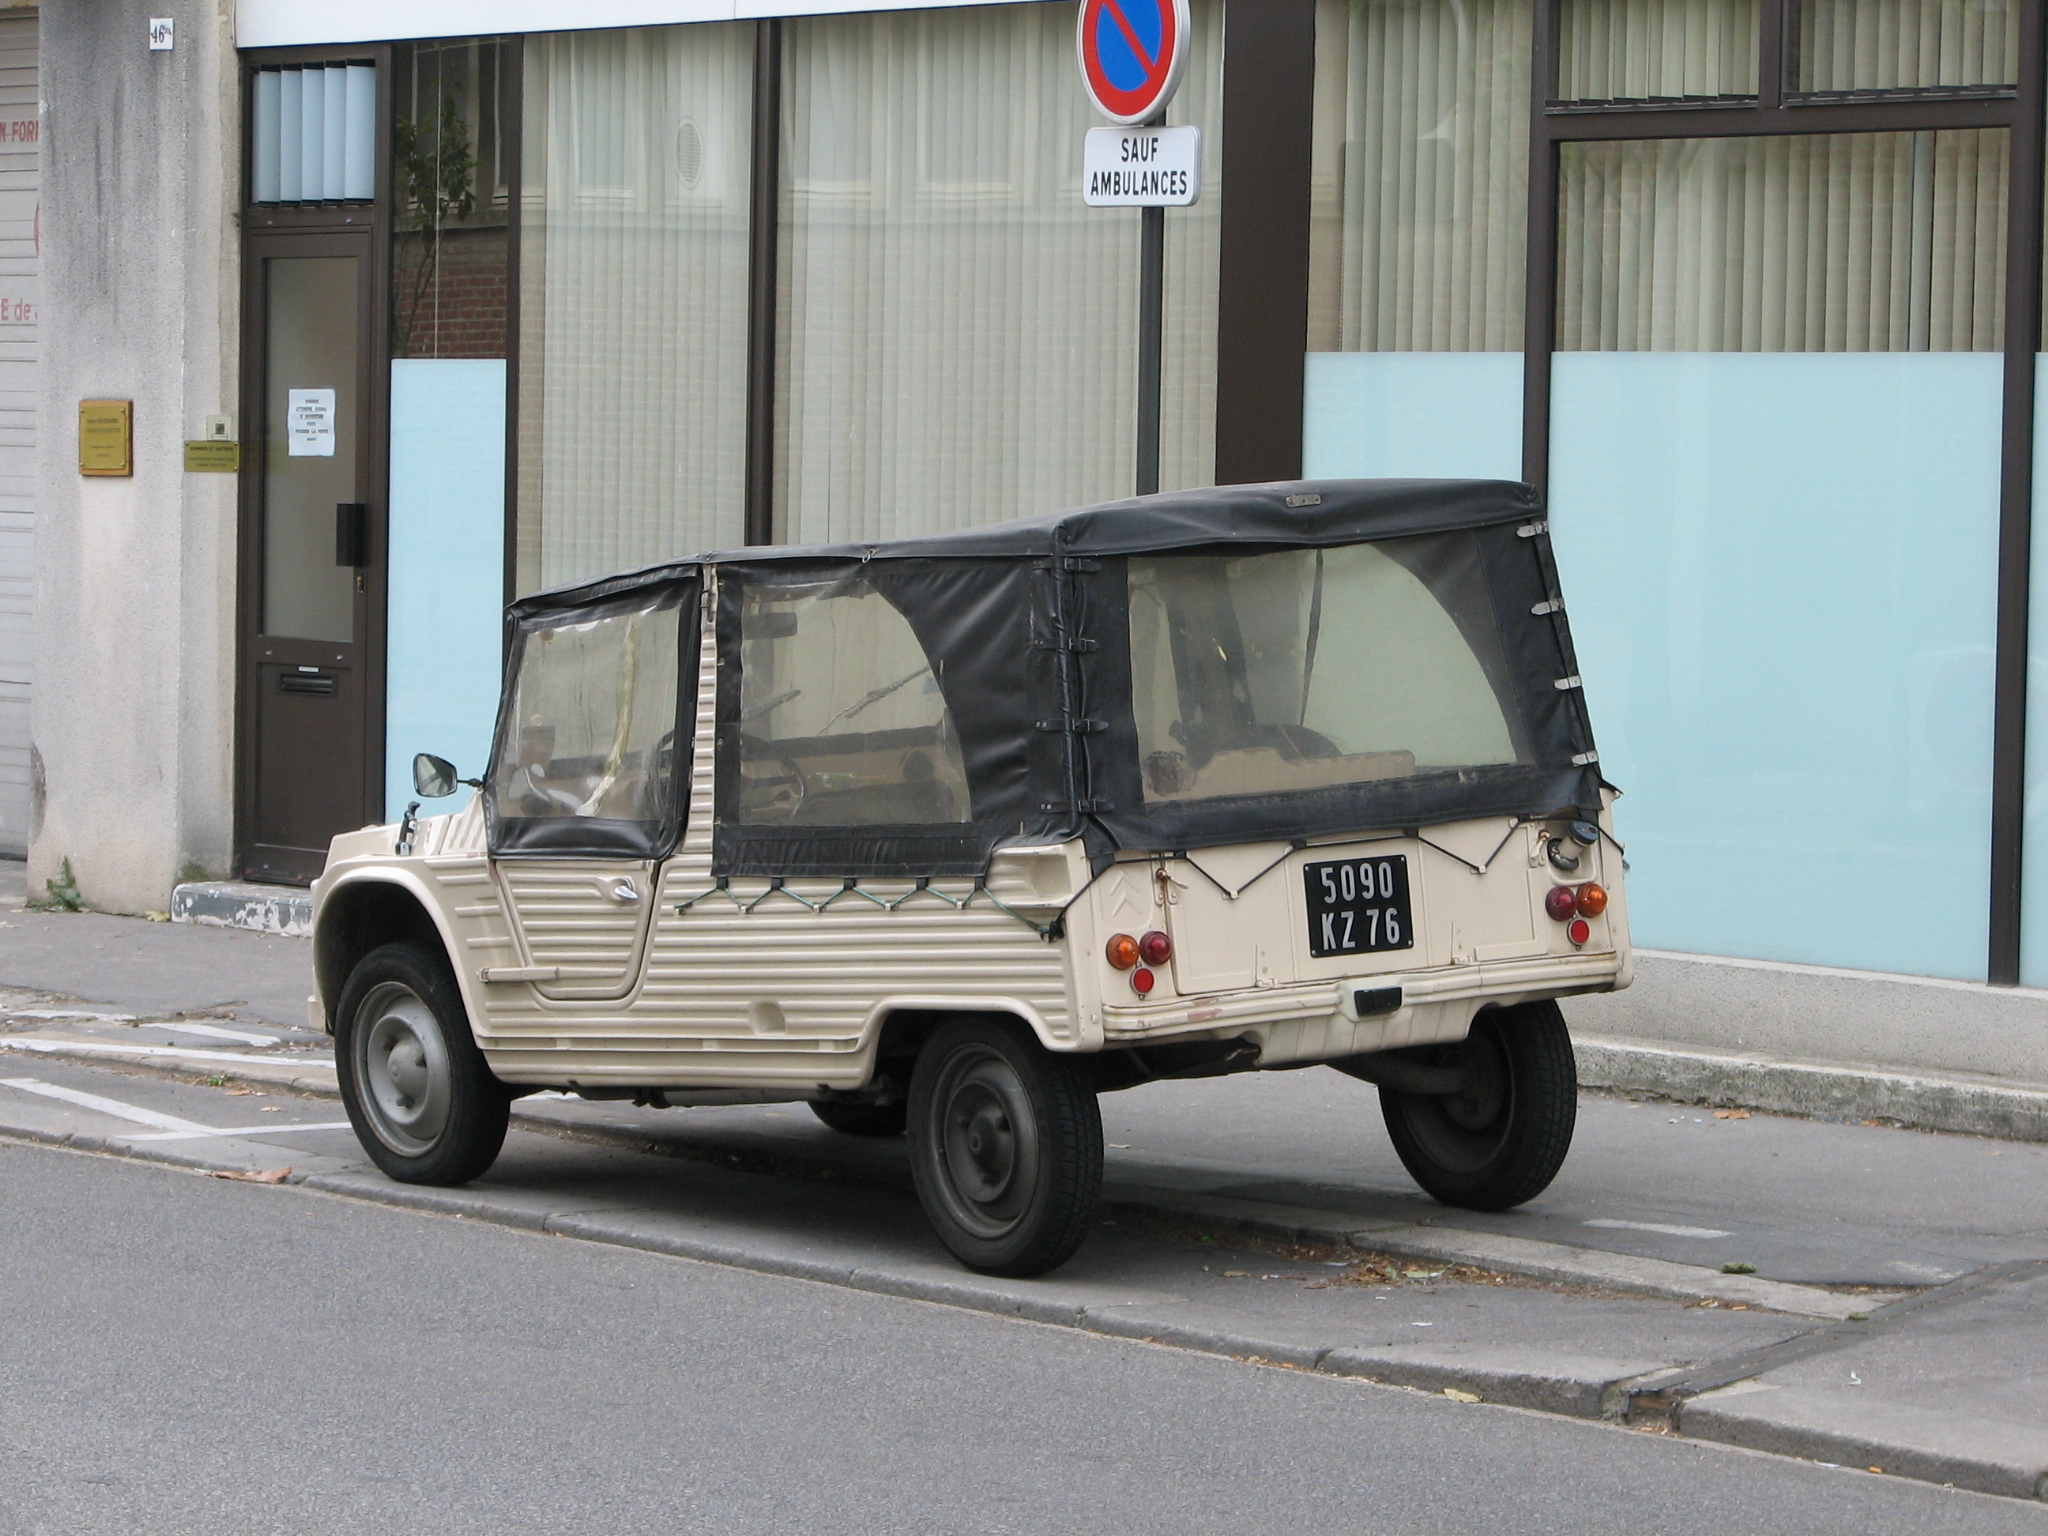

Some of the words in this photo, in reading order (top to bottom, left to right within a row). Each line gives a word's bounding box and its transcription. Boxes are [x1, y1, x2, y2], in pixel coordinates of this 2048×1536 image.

[1121, 137, 1159, 162] SAUF
[1090, 170, 1188, 196] AMBULANCES
[14, 298, 31, 321] de
[1320, 861, 1394, 904] 5090
[1321, 911, 1356, 951] KZ
[1366, 907, 1400, 946] 76
